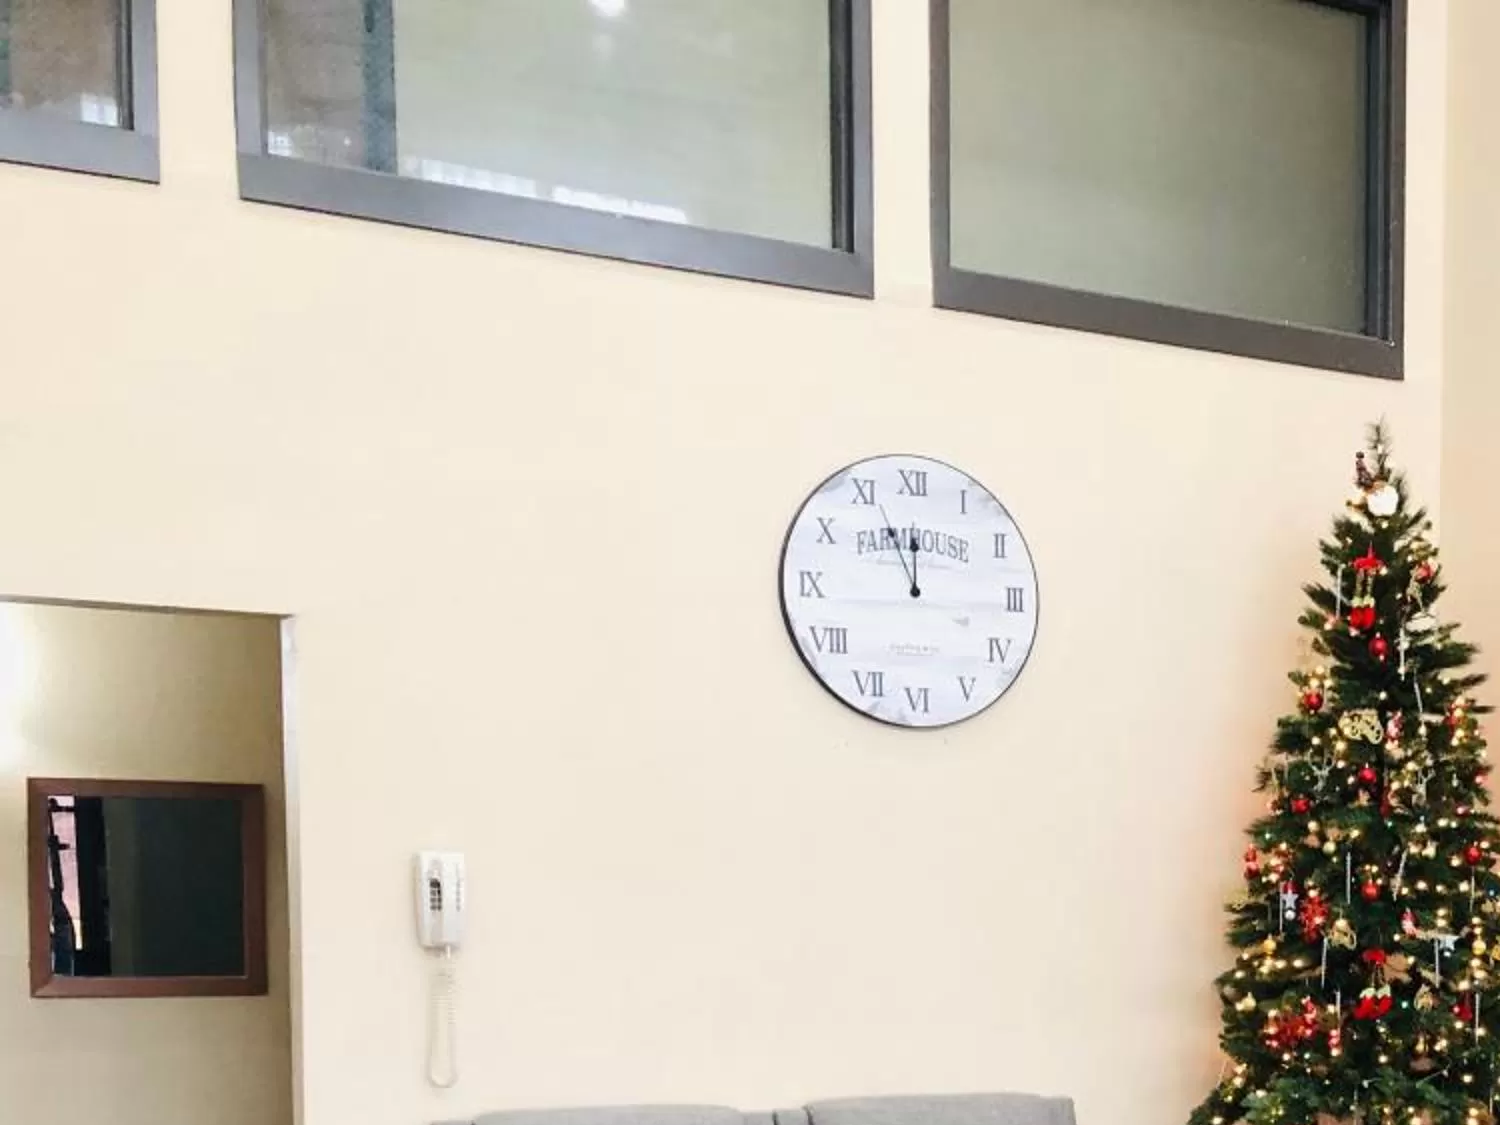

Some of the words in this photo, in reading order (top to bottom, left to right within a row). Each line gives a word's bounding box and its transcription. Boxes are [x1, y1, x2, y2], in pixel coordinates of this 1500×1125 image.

[851, 478, 876, 505] XI
[897, 469, 927, 497] XII
[960, 490, 968, 514] I
[816, 517, 836, 545] X
[856, 527, 969, 563] FARMHOUSE
[993, 533, 1007, 559] II
[800, 571, 825, 598] IX
[1005, 587, 1024, 612] III
[809, 626, 848, 654] VIII
[987, 637, 1012, 665] IV
[852, 670, 884, 697] VII
[957, 676, 977, 702] V
[904, 687, 931, 714] VI
